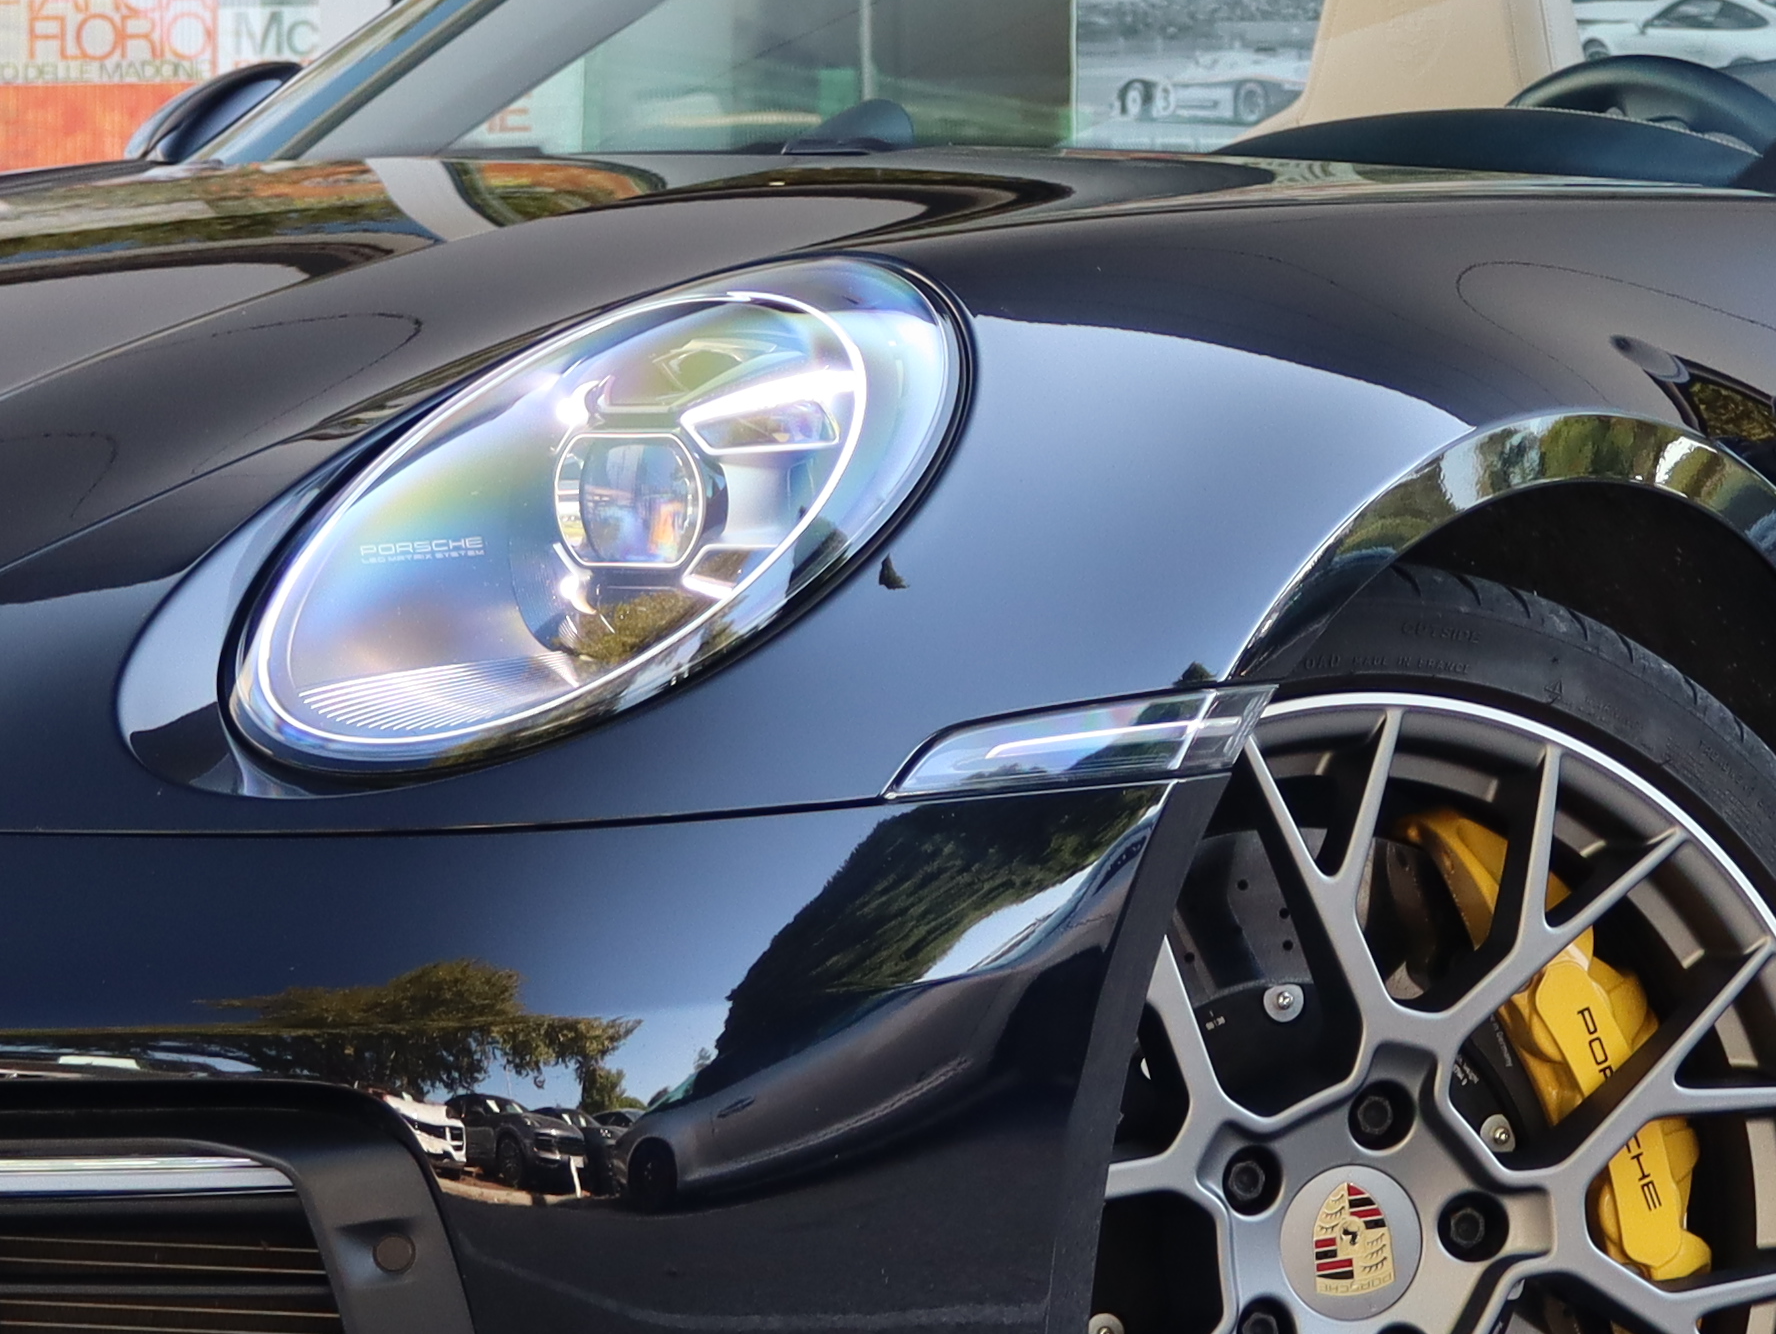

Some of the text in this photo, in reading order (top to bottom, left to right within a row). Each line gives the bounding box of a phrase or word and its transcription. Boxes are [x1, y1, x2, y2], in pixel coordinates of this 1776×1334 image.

[28, 12, 212, 60] FLORIO
[360, 536, 483, 556] PORSCHE
[1322, 1271, 1393, 1295] PORSCHE
